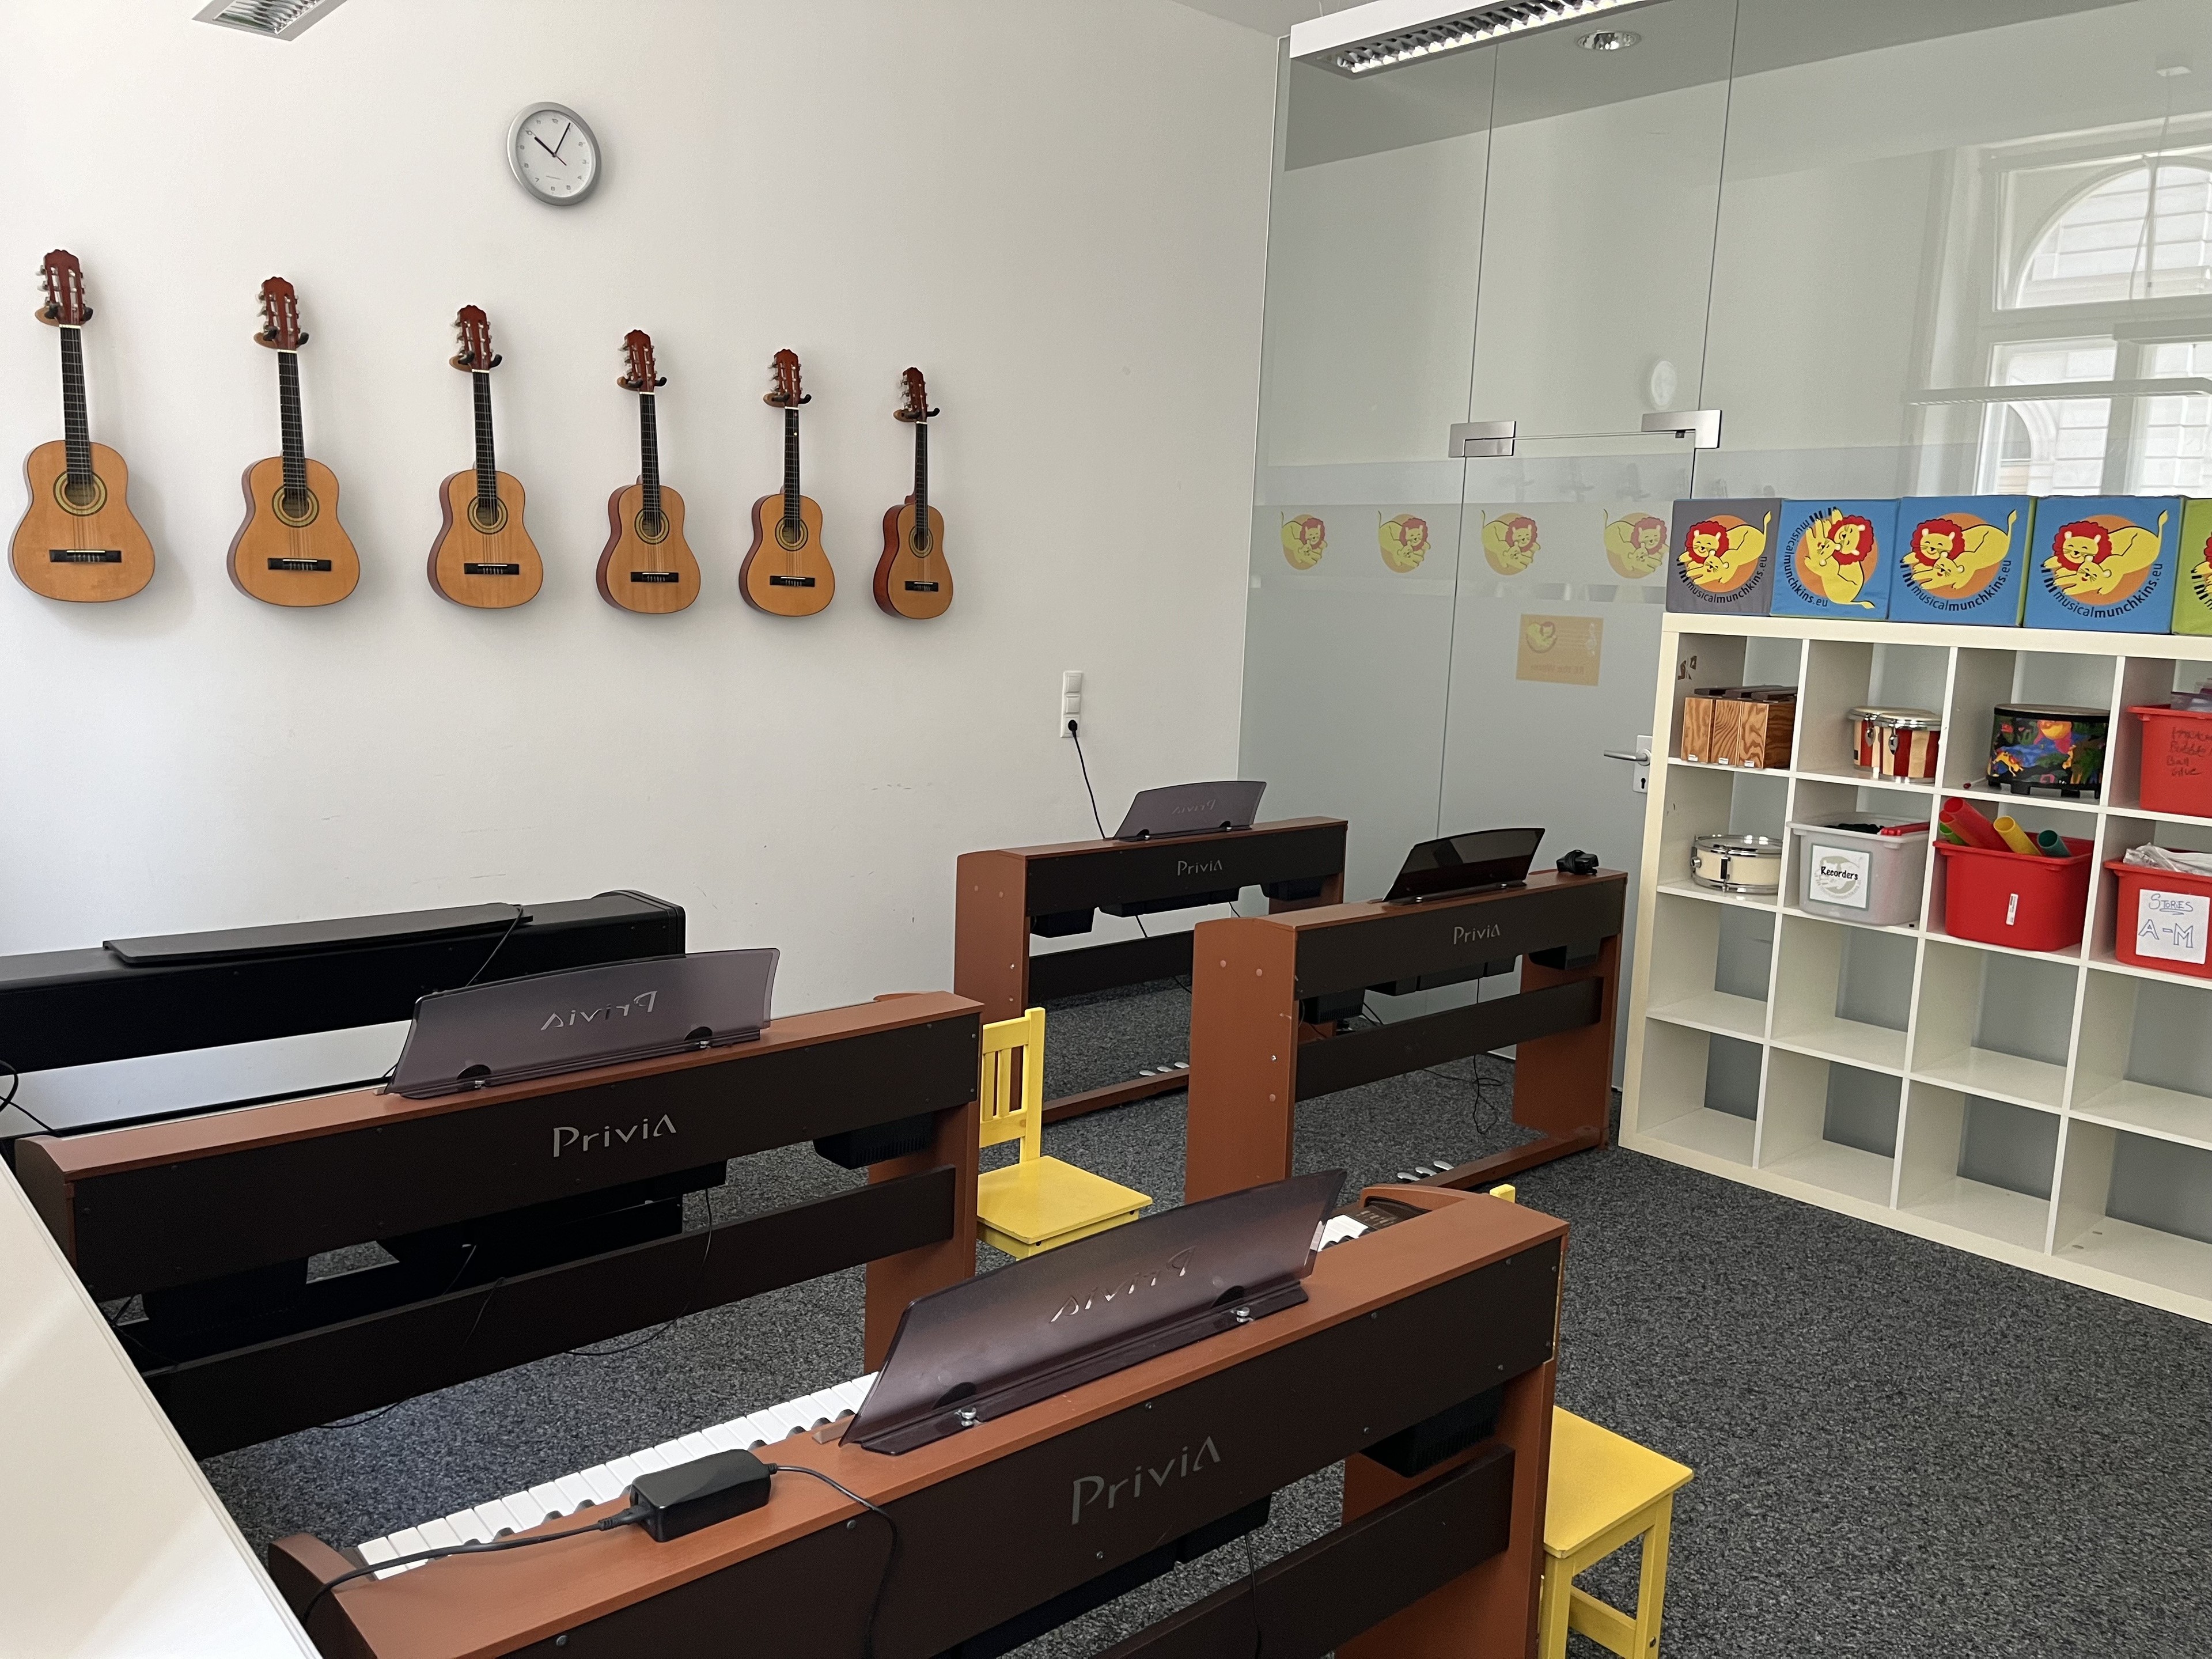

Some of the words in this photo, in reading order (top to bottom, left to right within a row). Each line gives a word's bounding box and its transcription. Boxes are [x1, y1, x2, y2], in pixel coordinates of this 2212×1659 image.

[1686, 556, 1768, 603] musicalmunchkins.eu
[1784, 520, 1828, 607] musicalmunchkins.eu
[1911, 560, 2012, 611] musicalmunchkins.eu
[2054, 563, 2163, 618] musicalmunchkins.eu
[1177, 859, 1222, 876] Privia
[1821, 866, 1858, 880] Recorders
[1453, 923, 1500, 945] Privia
[553, 1114, 677, 1158] Privia
[1071, 1435, 1221, 1525] Privia
